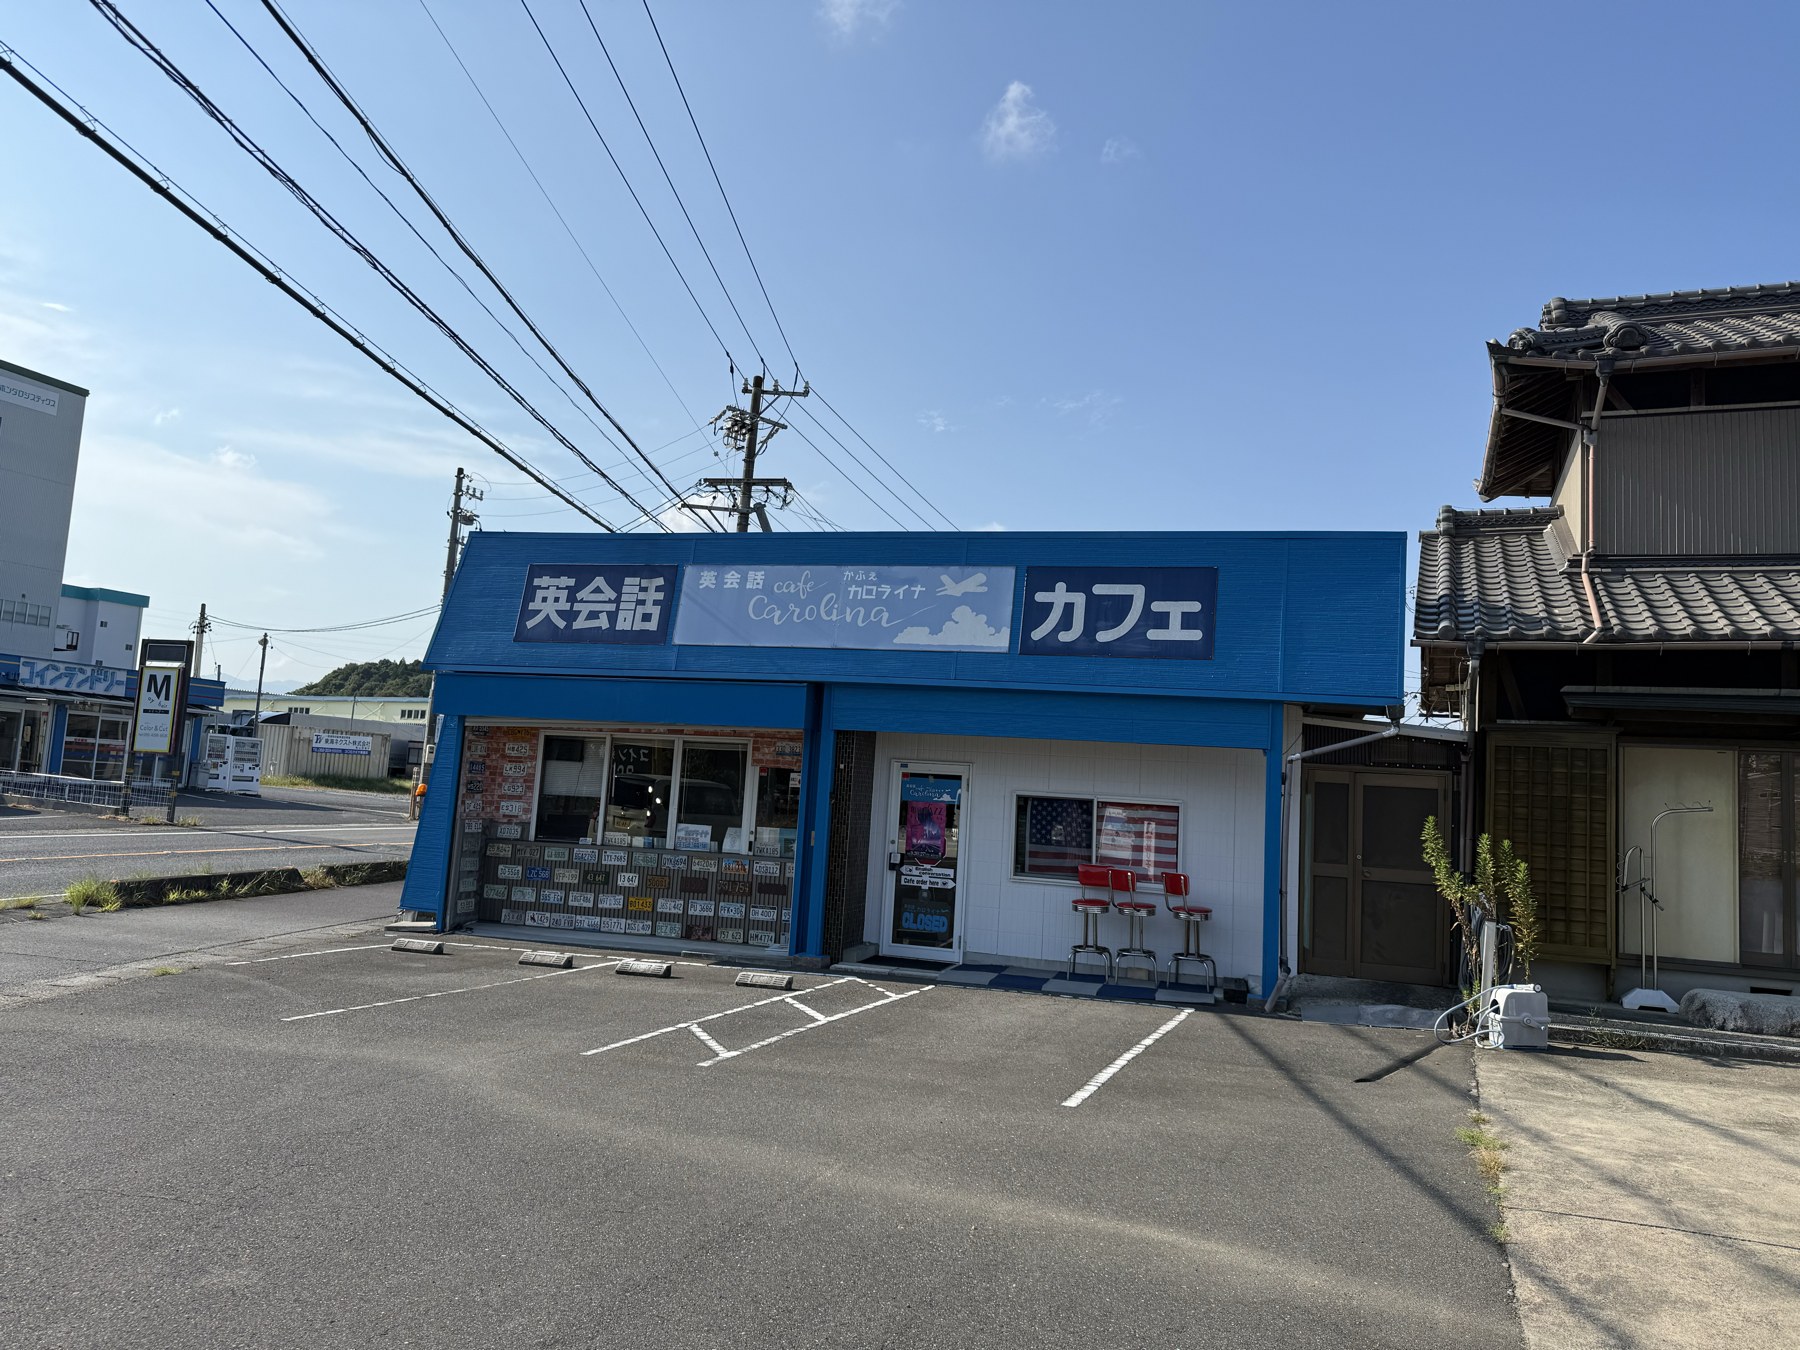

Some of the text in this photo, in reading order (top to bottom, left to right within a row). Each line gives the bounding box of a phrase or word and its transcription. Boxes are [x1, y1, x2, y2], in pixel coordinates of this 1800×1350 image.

[699, 571, 765, 590] 英会話
[847, 584, 926, 599] カロライナ
[526, 576, 665, 631] 英会話
[748, 593, 925, 629] Carolina
[1031, 582, 1203, 643] カフェ
[21, 661, 125, 692] コインランドリー
[904, 877, 914, 885] Cafe
[902, 911, 948, 933] CLOSED
